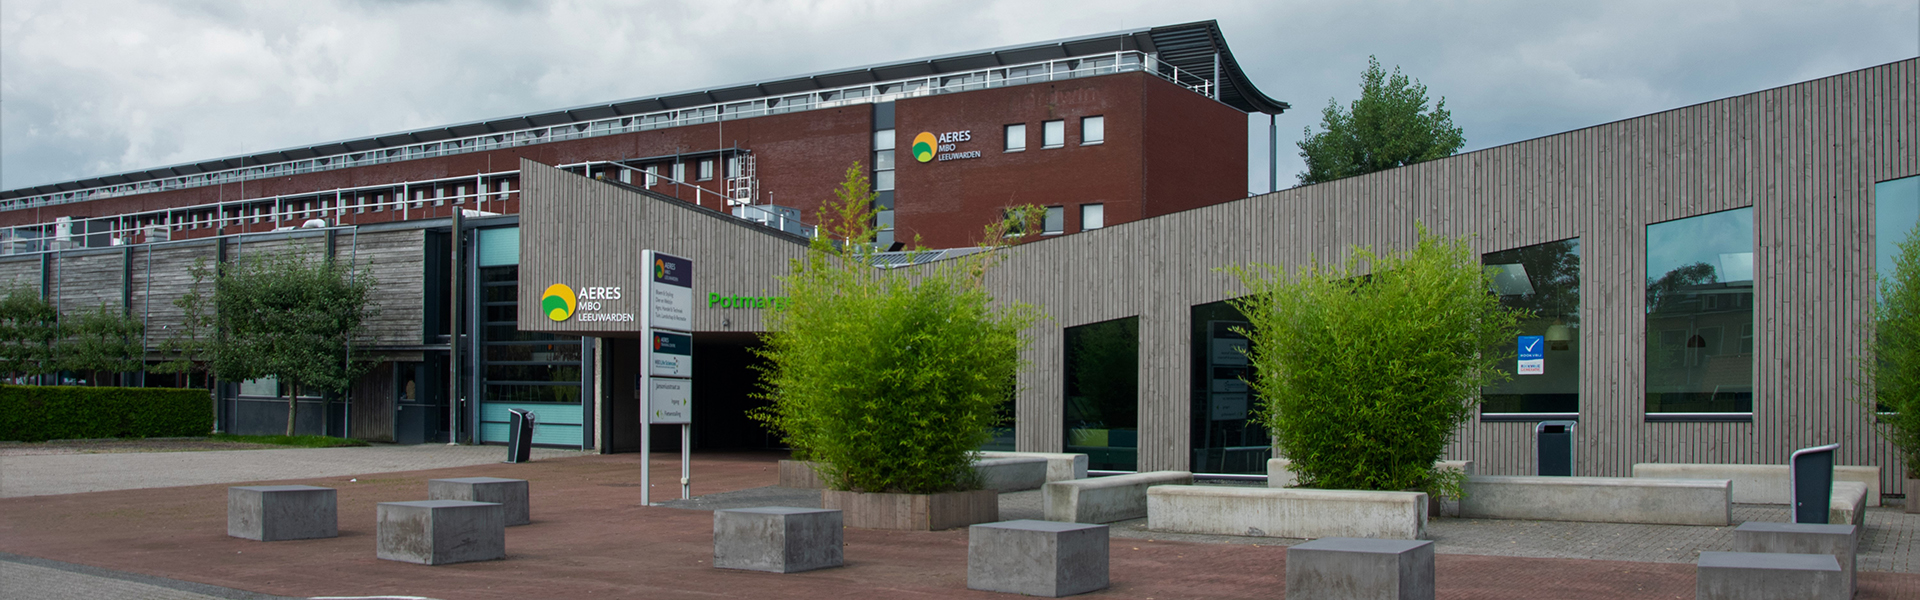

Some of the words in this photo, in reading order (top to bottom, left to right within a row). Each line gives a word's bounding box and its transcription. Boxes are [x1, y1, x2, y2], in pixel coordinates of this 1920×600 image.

[938, 130, 971, 143] AERES
[938, 144, 956, 152] MBO
[938, 151, 981, 161] LEEUWARDEN
[665, 262, 676, 270] AERES
[578, 287, 621, 300] AERES
[578, 302, 601, 311] MBO
[578, 314, 635, 322] LEEUWARDEN
